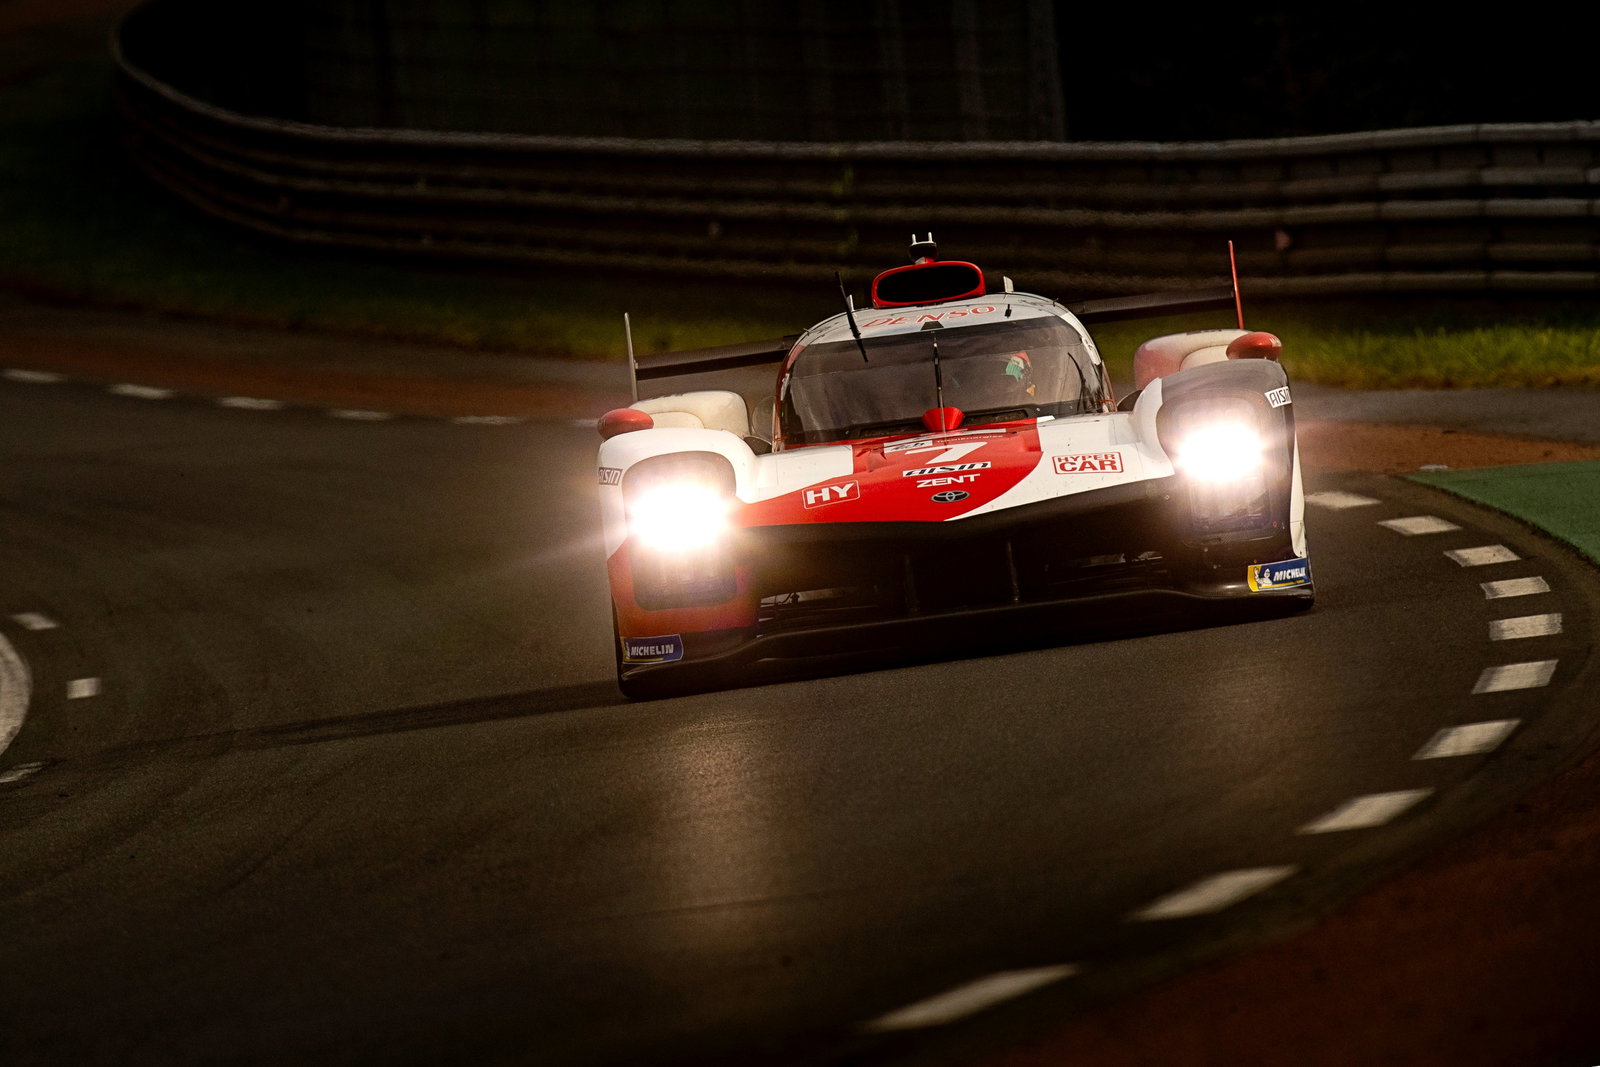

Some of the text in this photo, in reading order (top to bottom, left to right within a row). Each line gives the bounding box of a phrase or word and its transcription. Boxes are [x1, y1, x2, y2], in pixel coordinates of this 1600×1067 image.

[862, 306, 995, 328] DENSO
[905, 441, 988, 465] 7
[1057, 454, 1116, 462] HYPER
[905, 462, 989, 476] AISIN
[1059, 460, 1118, 472] CAR
[916, 473, 981, 488] ZENT
[806, 483, 855, 504] HY
[630, 644, 674, 656] MICHELIN
